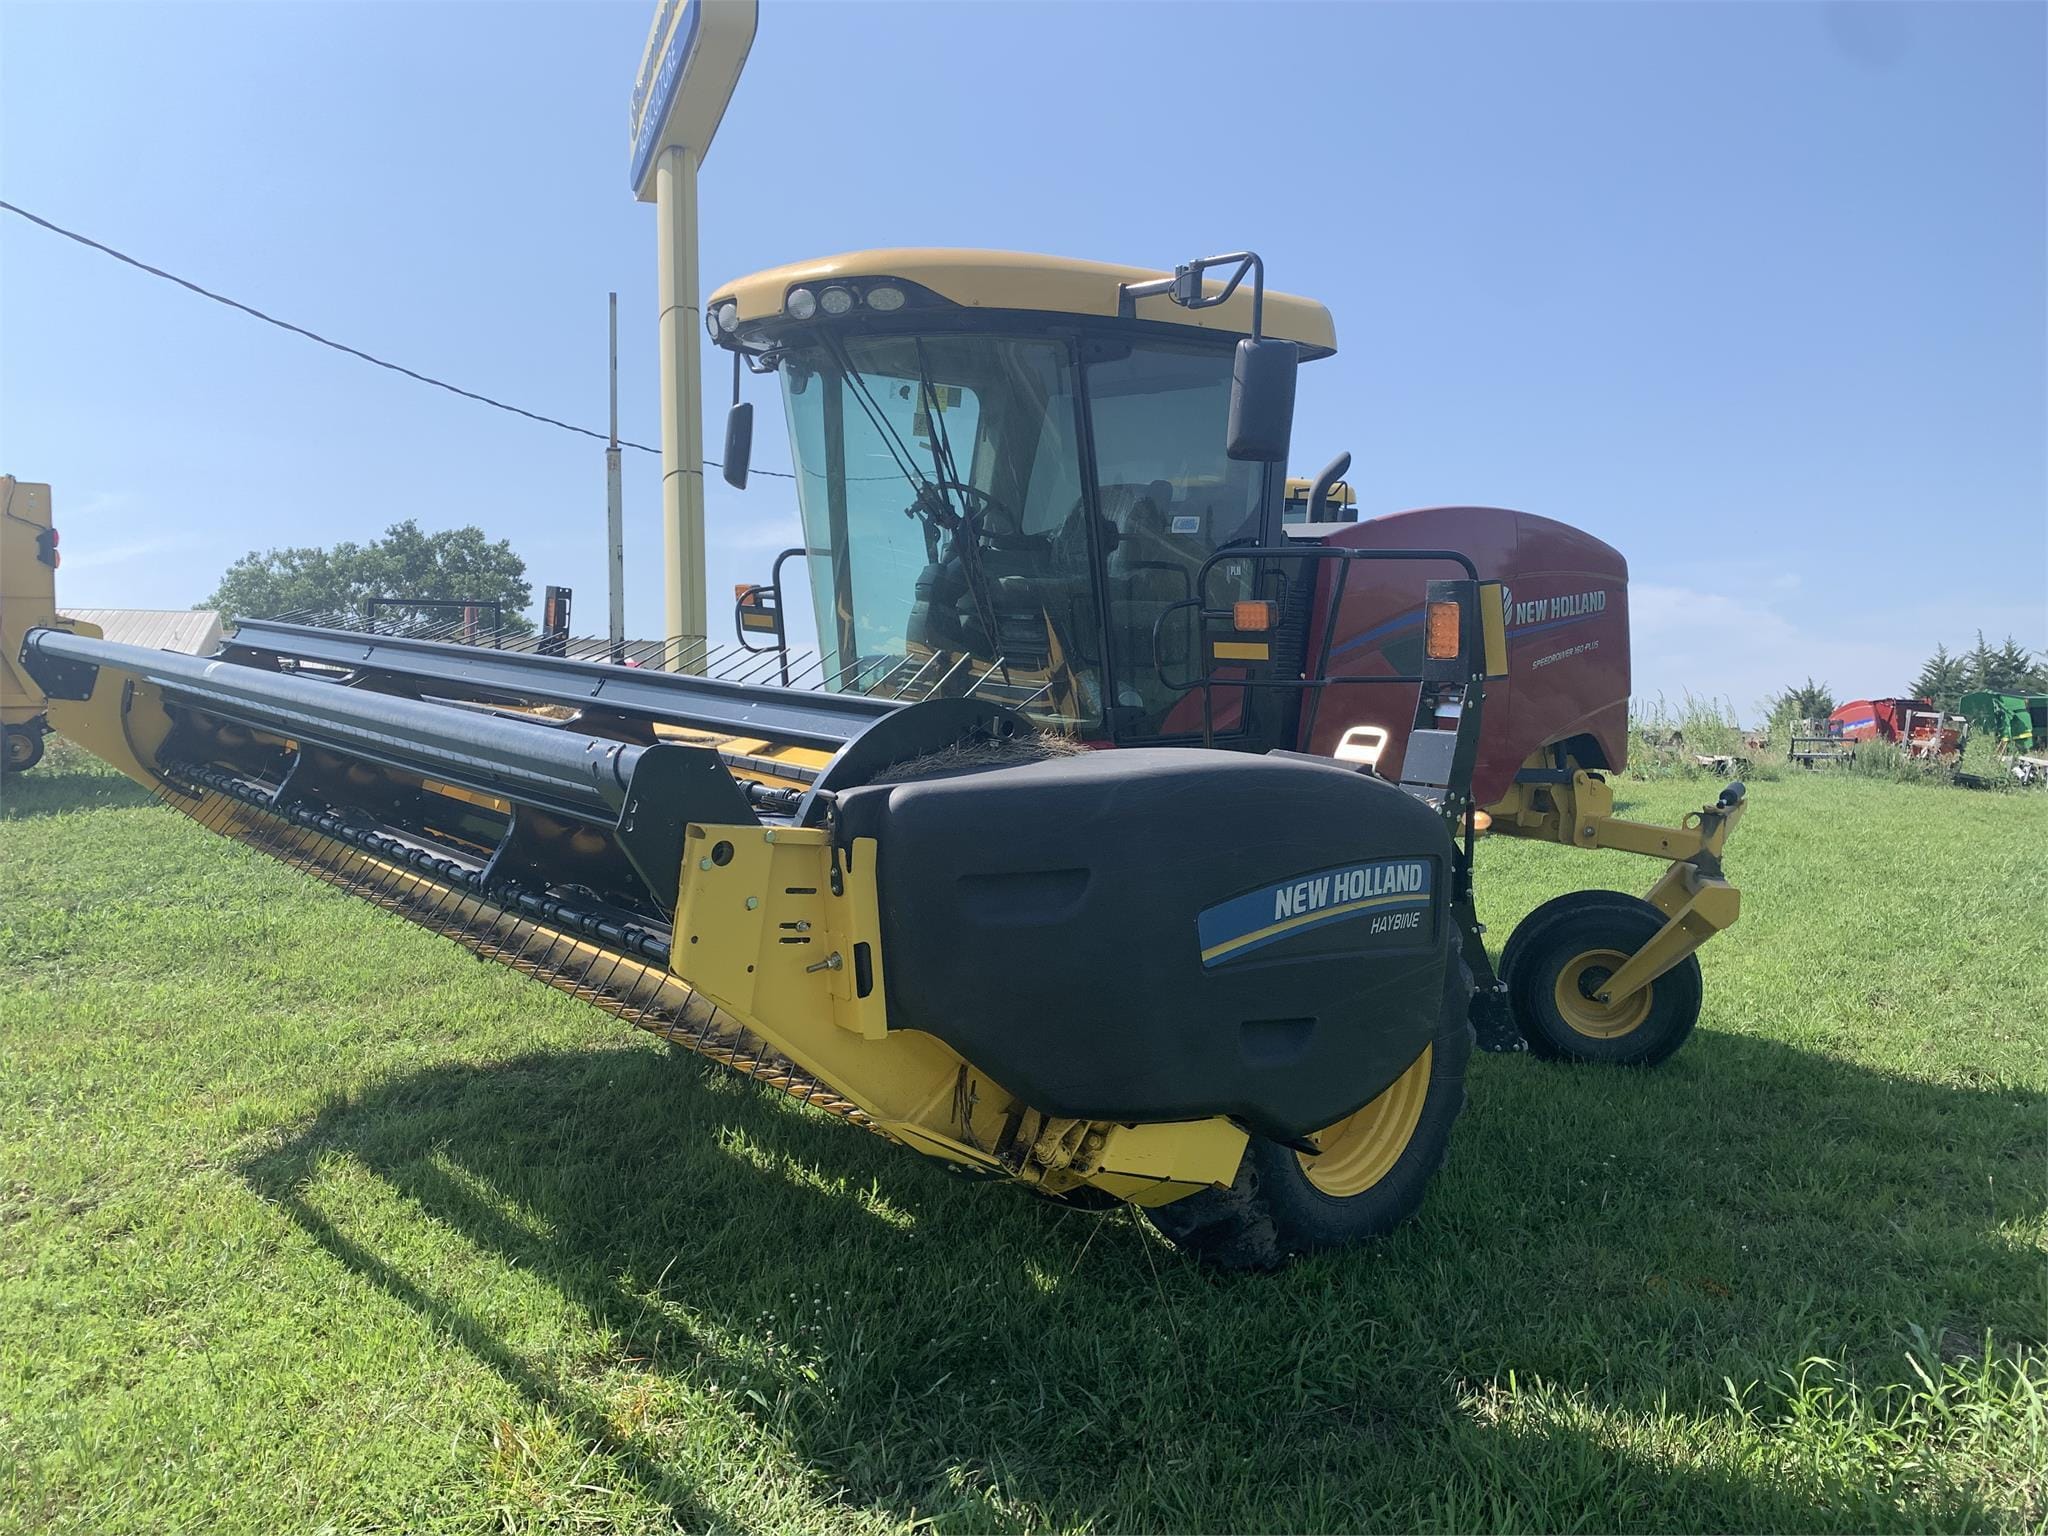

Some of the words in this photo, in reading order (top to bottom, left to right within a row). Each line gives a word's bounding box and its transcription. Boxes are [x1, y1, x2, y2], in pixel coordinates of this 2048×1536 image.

[639, 40, 676, 160] AGRICULTURE
[1516, 599, 1548, 625] NEW
[1551, 590, 1605, 619] HOLLAND
[1275, 877, 1330, 920] NEW
[1333, 864, 1423, 904] HOLLAND
[1370, 911, 1421, 935] HAYBINE
